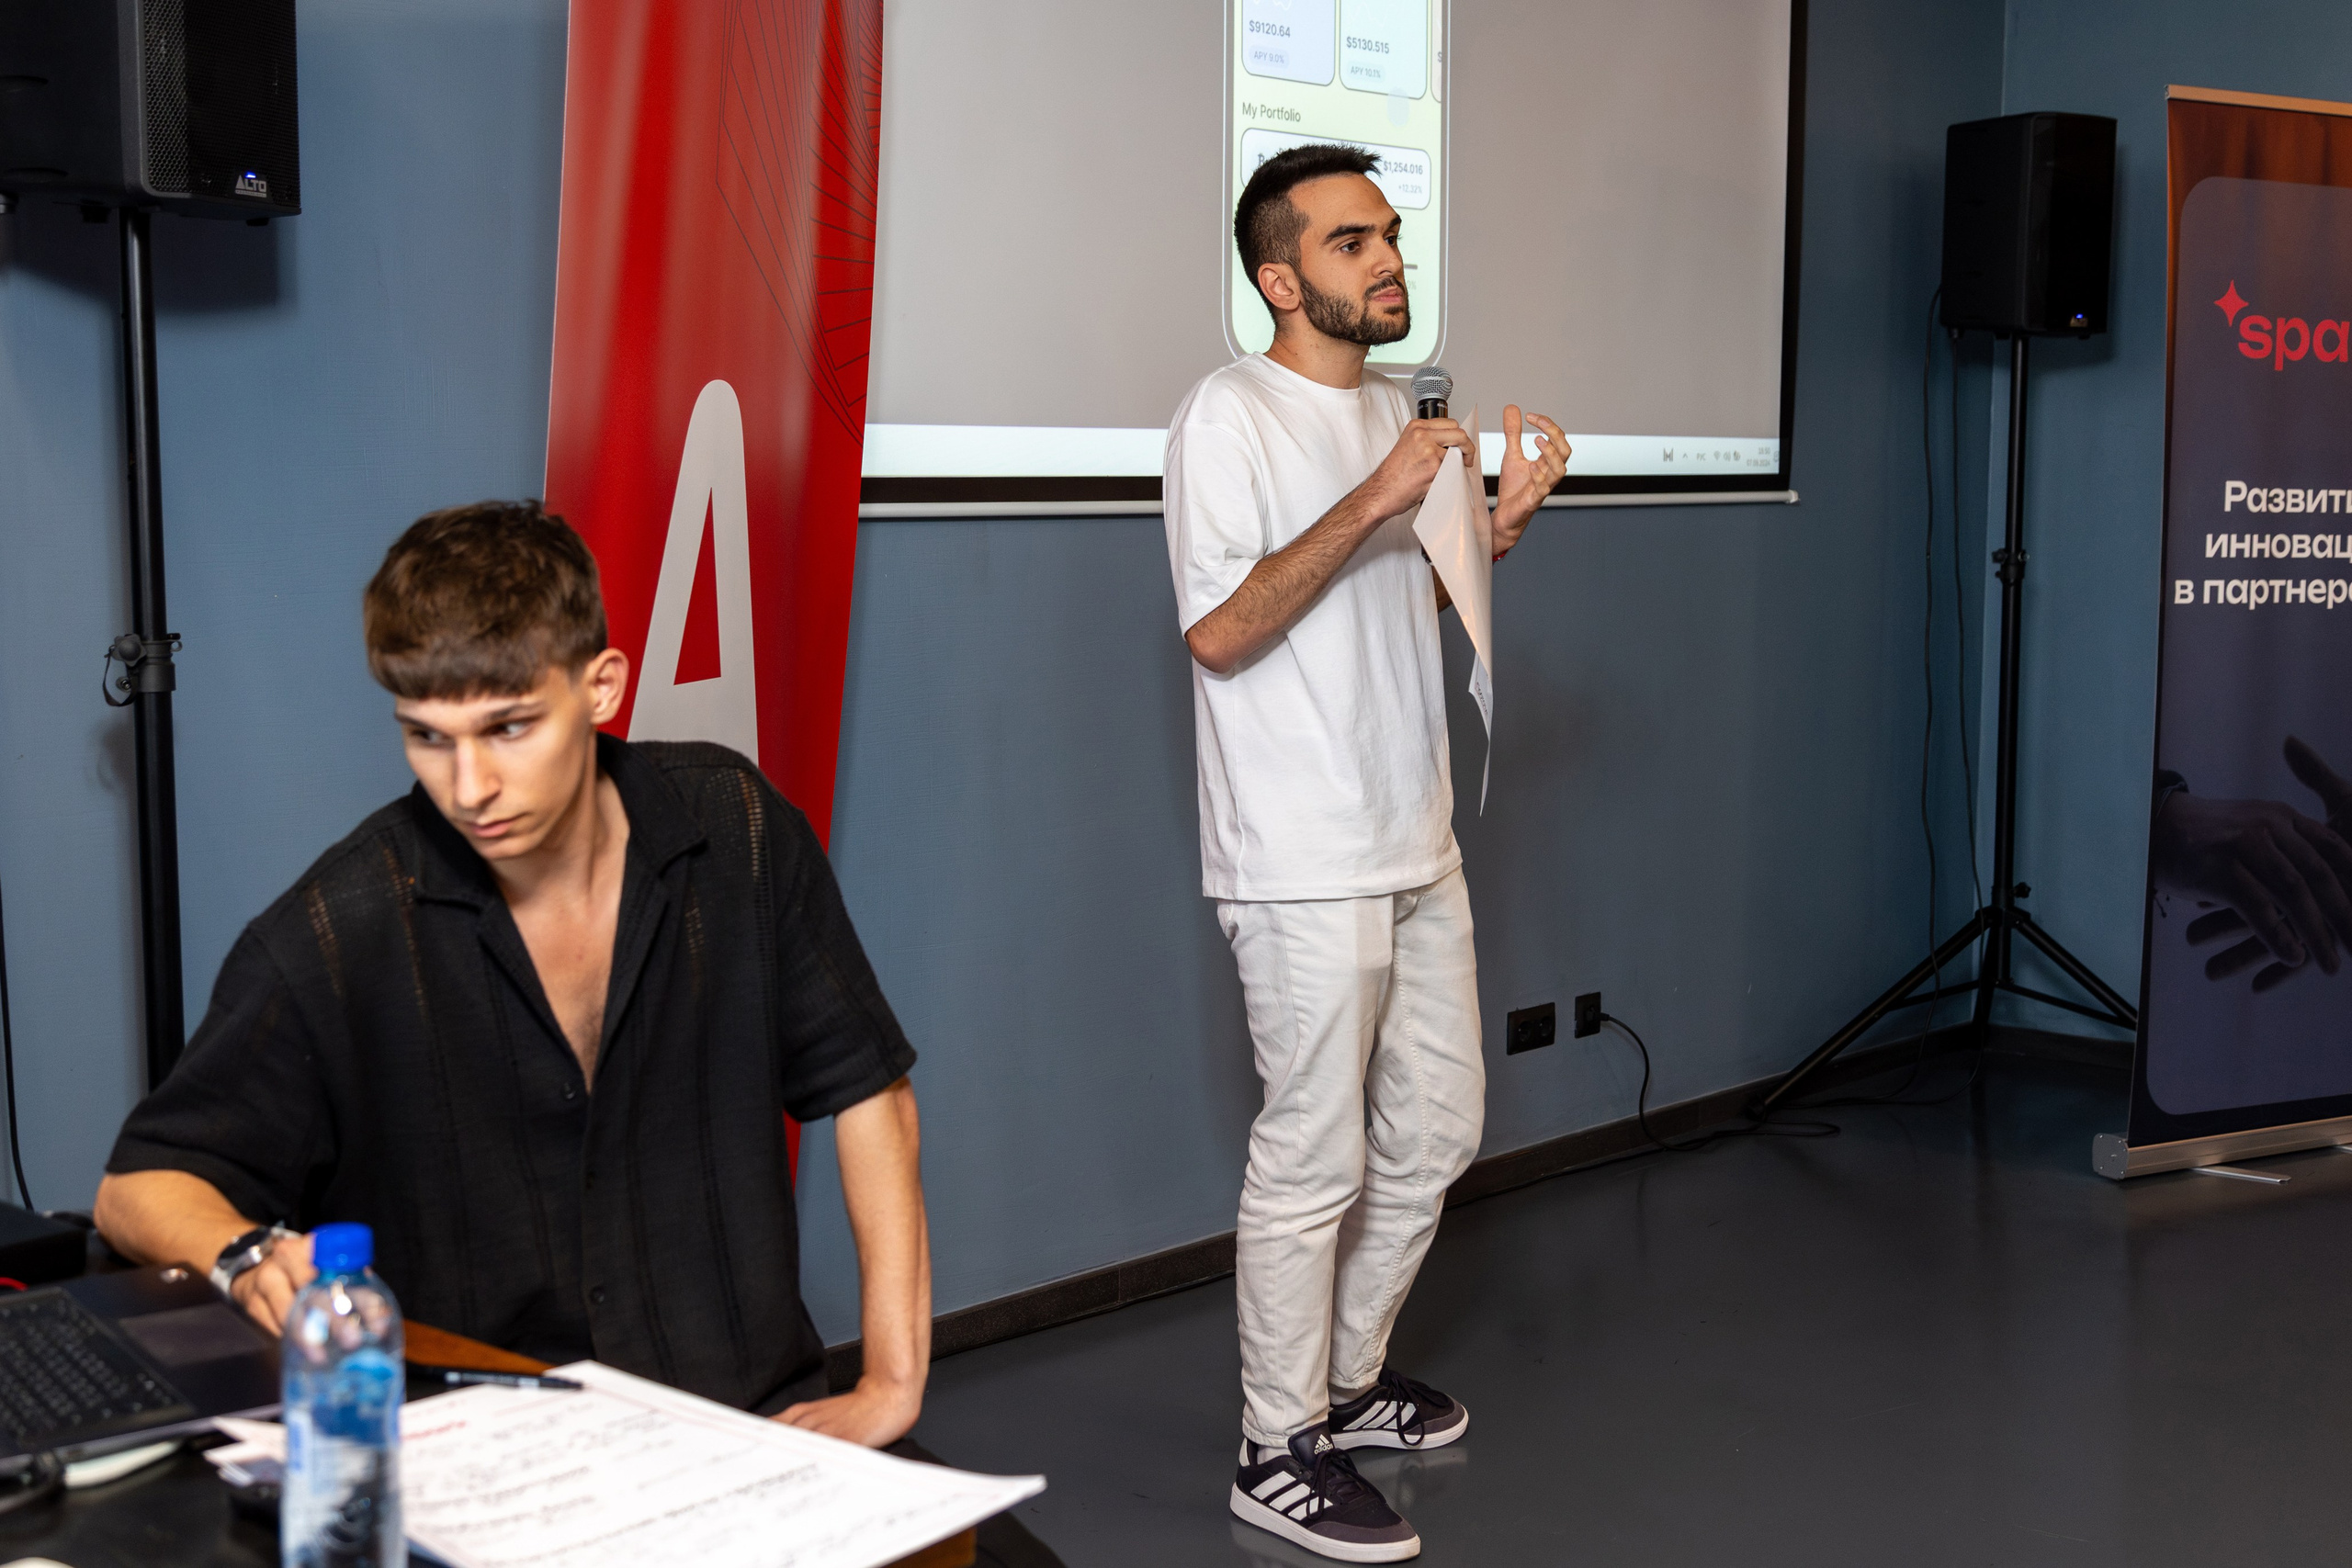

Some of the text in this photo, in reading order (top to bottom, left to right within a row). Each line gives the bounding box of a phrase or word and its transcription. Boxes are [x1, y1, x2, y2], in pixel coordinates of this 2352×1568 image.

[1249, 19, 1291, 38] $9120.64
[1346, 36, 1390, 54] $5130.515
[1253, 51, 1284, 63] APY 9.0%
[1350, 65, 1363, 75] APY
[1242, 102, 1301, 122] My Portfolio
[1383, 160, 1423, 175] $1,254.016
[235, 175, 267, 193] ALTO
[2238, 315, 2350, 371] spa
[2205, 533, 2352, 564] инновац
[2174, 578, 2352, 610] в партнер
